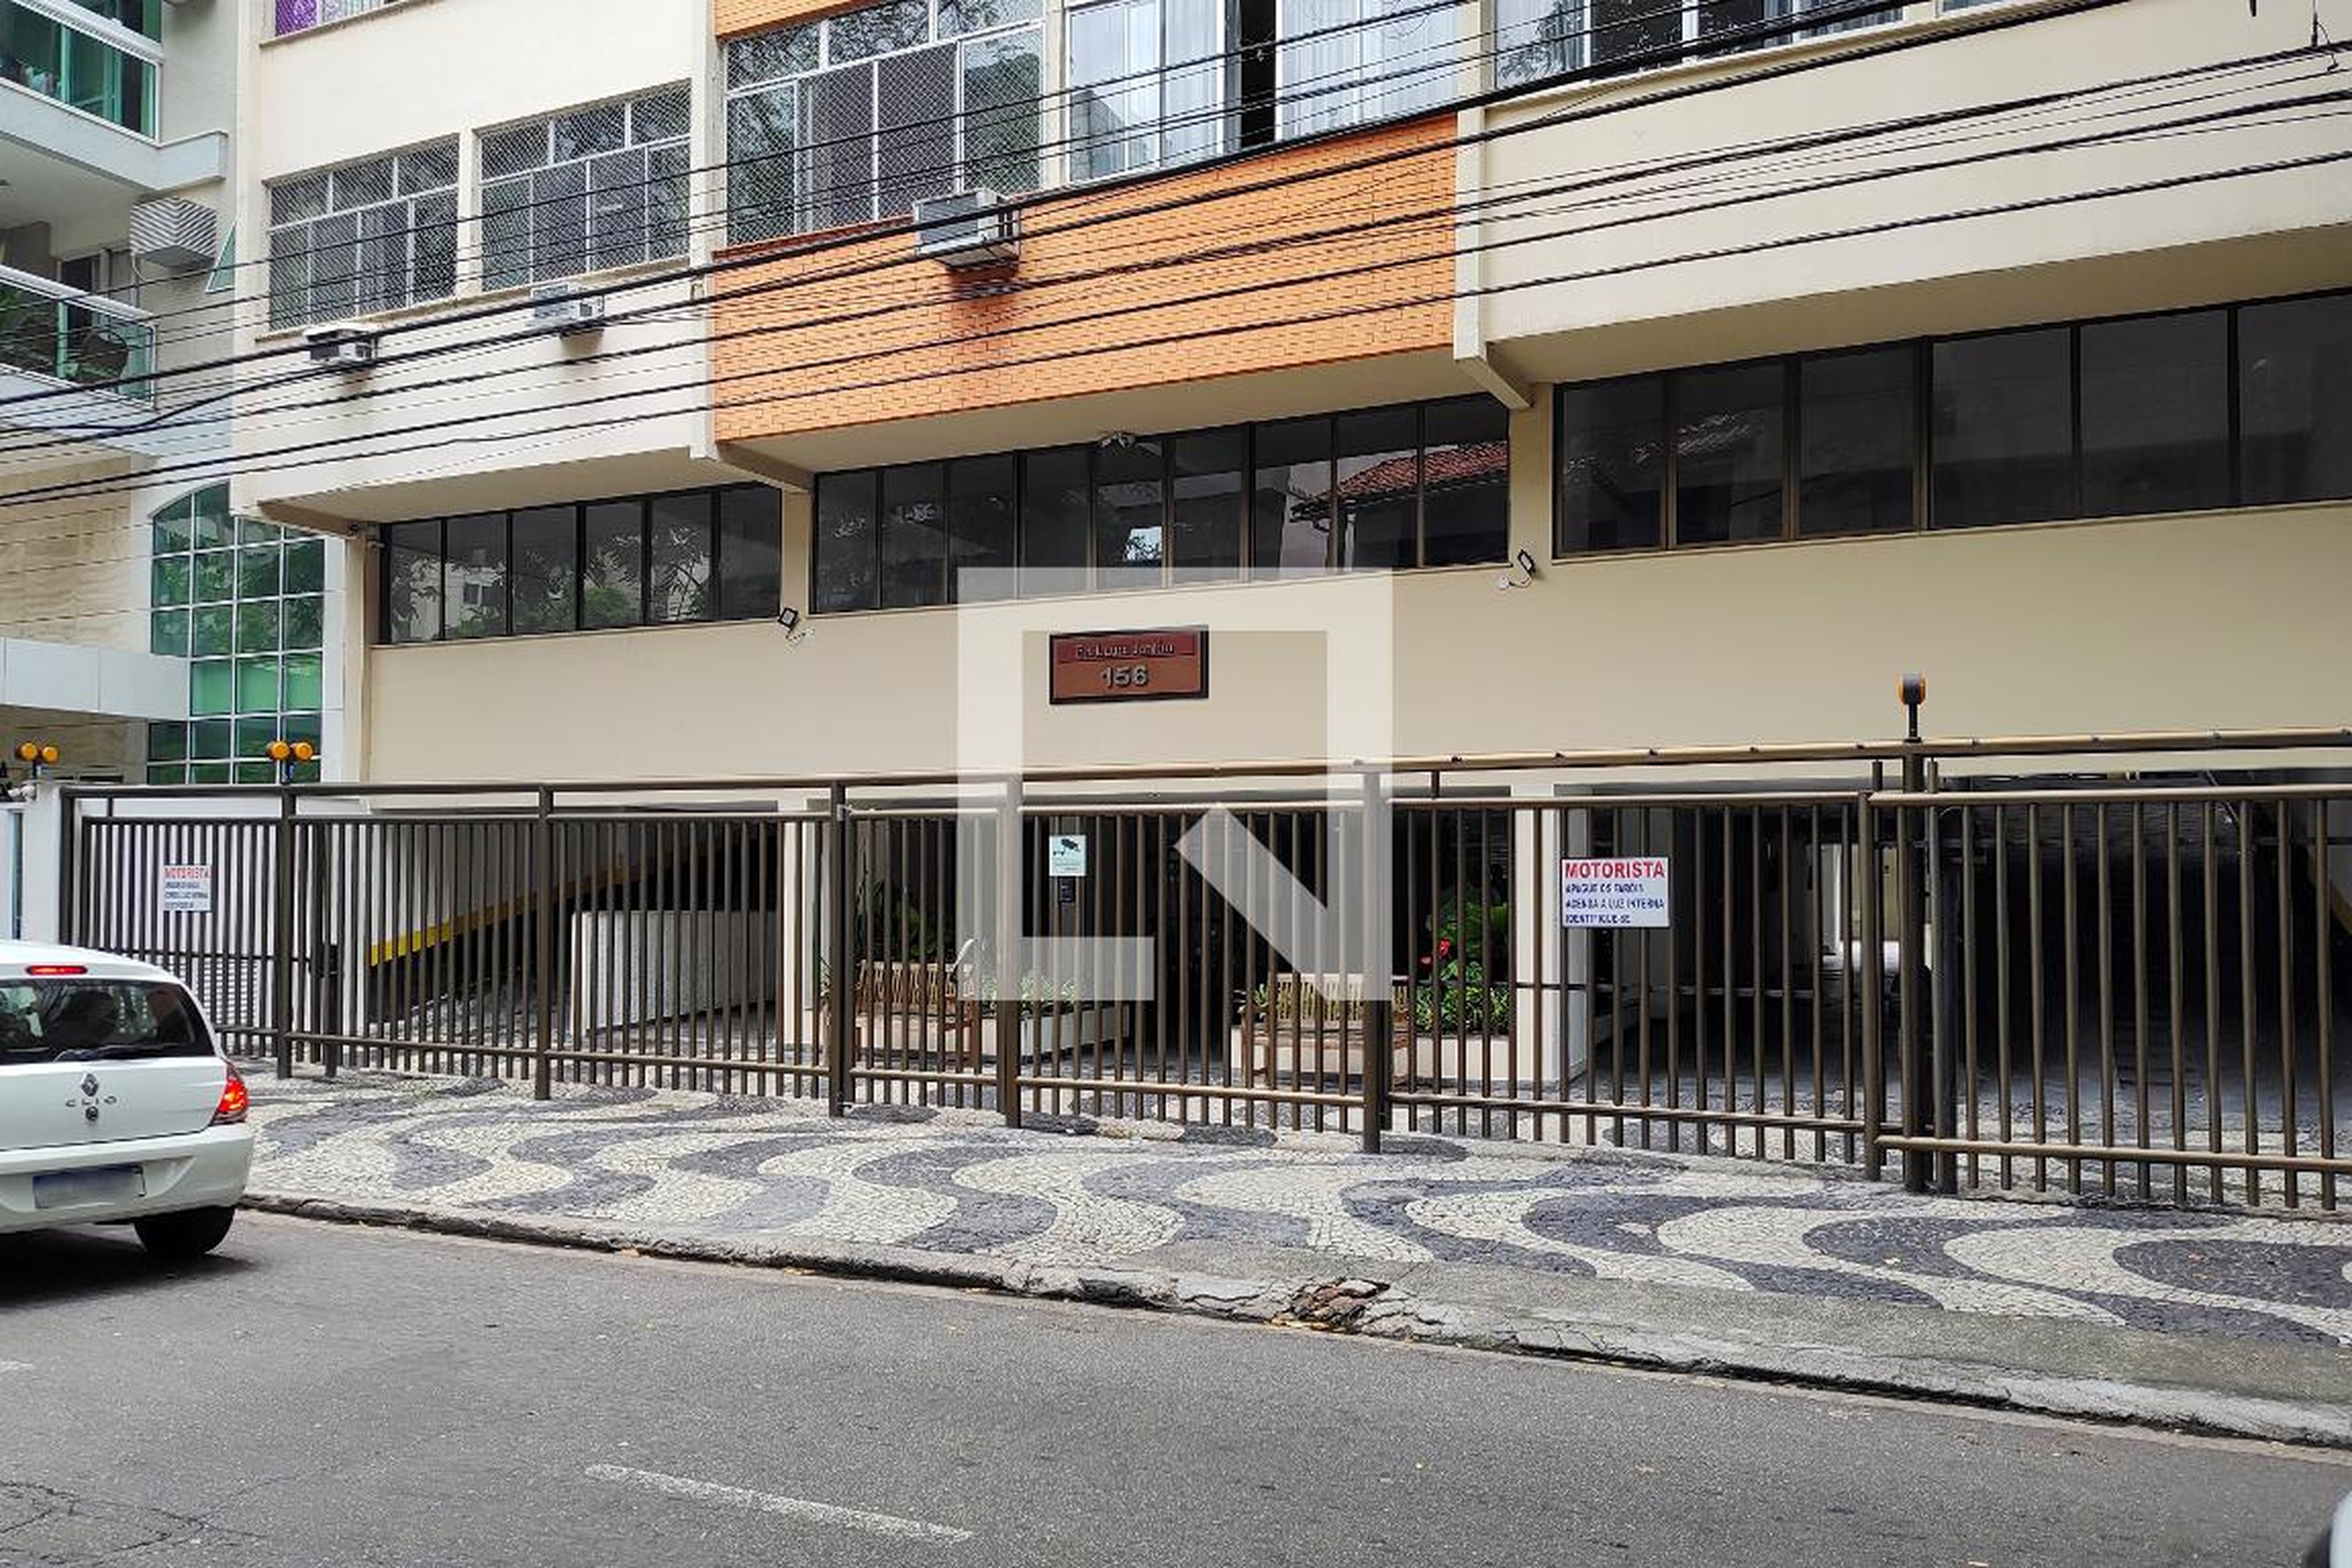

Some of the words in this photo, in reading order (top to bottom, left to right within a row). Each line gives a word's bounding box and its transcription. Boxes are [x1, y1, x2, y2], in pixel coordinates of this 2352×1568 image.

[1101, 665, 1149, 687] 156
[1565, 861, 1665, 878] MOTORISTA
[65, 1095, 117, 1107] CLIO
